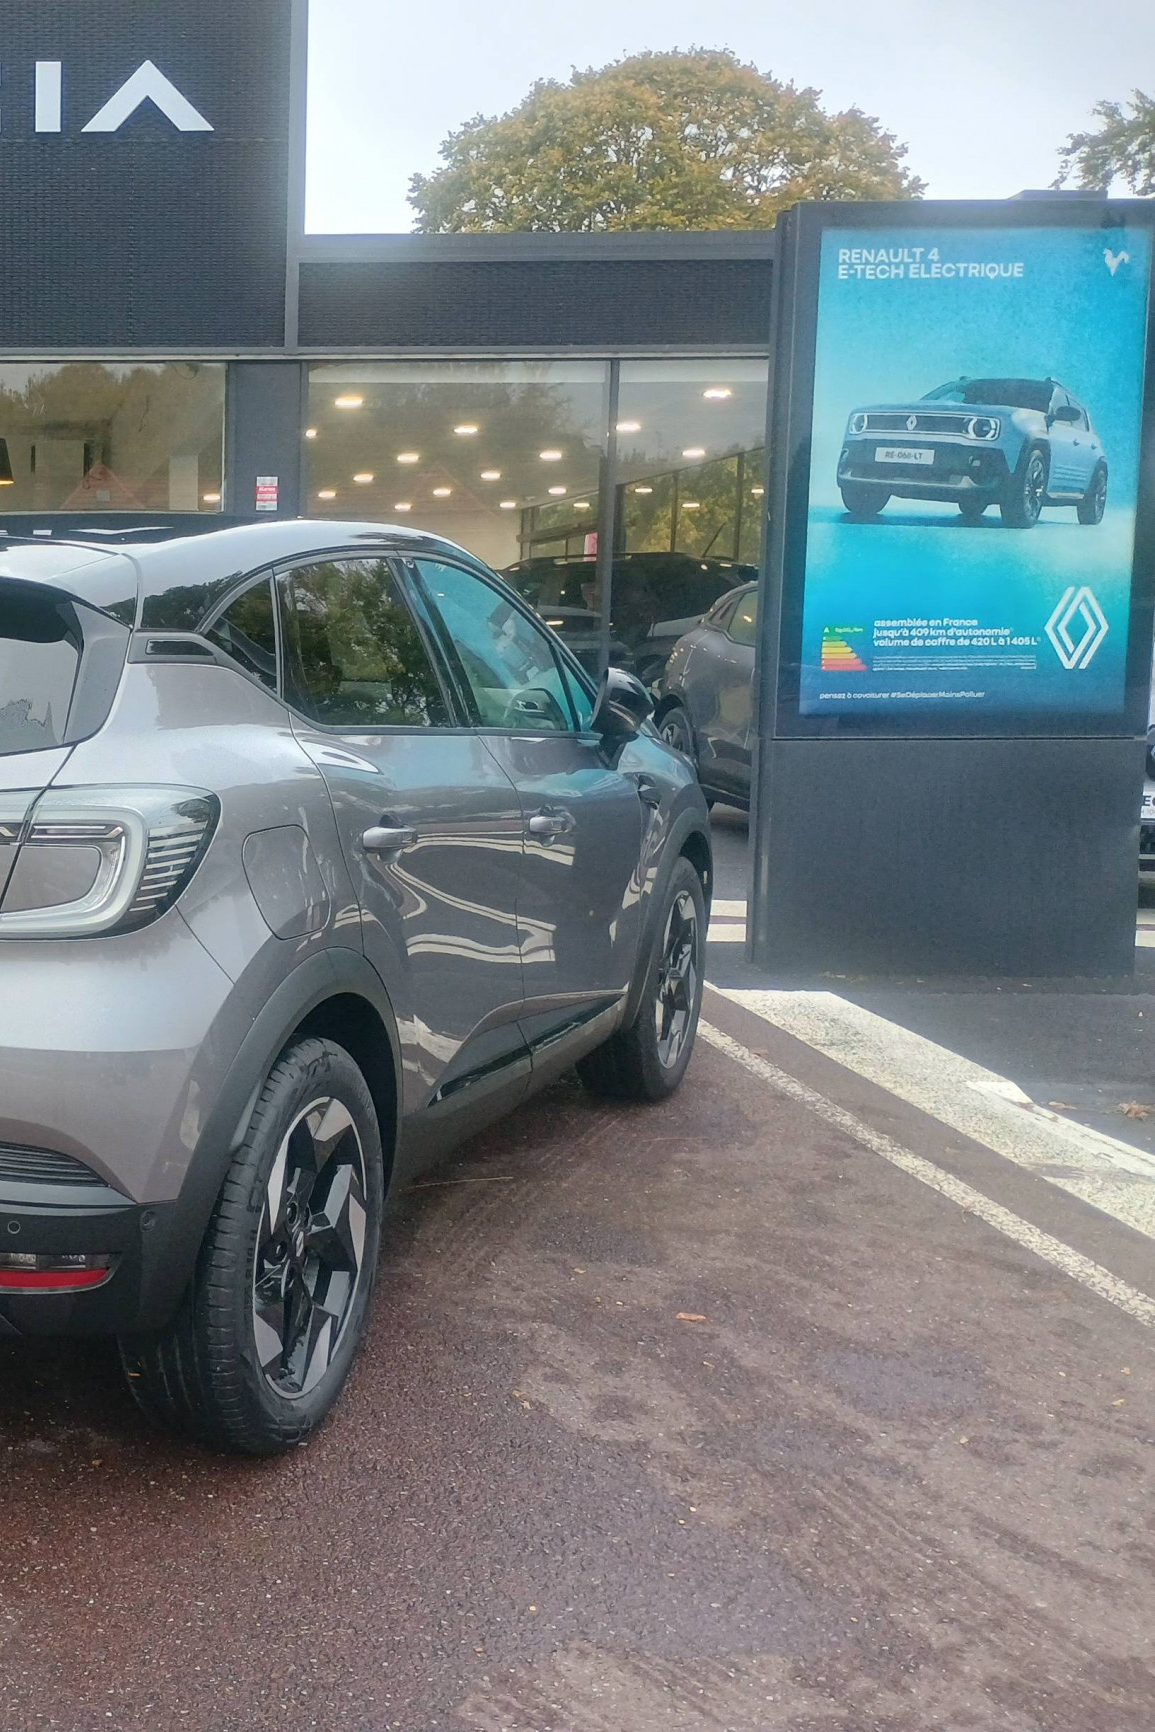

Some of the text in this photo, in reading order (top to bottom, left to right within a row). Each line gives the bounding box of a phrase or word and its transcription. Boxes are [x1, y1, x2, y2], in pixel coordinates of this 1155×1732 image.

[838, 247, 940, 264] RENAULT 4
[838, 262, 1025, 280] E-TECH ELECTRIQUE
[873, 617, 979, 627] assemblée en France
[910, 627, 930, 637] 409
[930, 627, 946, 637] km
[873, 637, 910, 647] volume
[911, 637, 924, 647] de
[925, 637, 956, 647] coffre
[956, 636, 970, 646] de
[971, 636, 990, 646] 420
